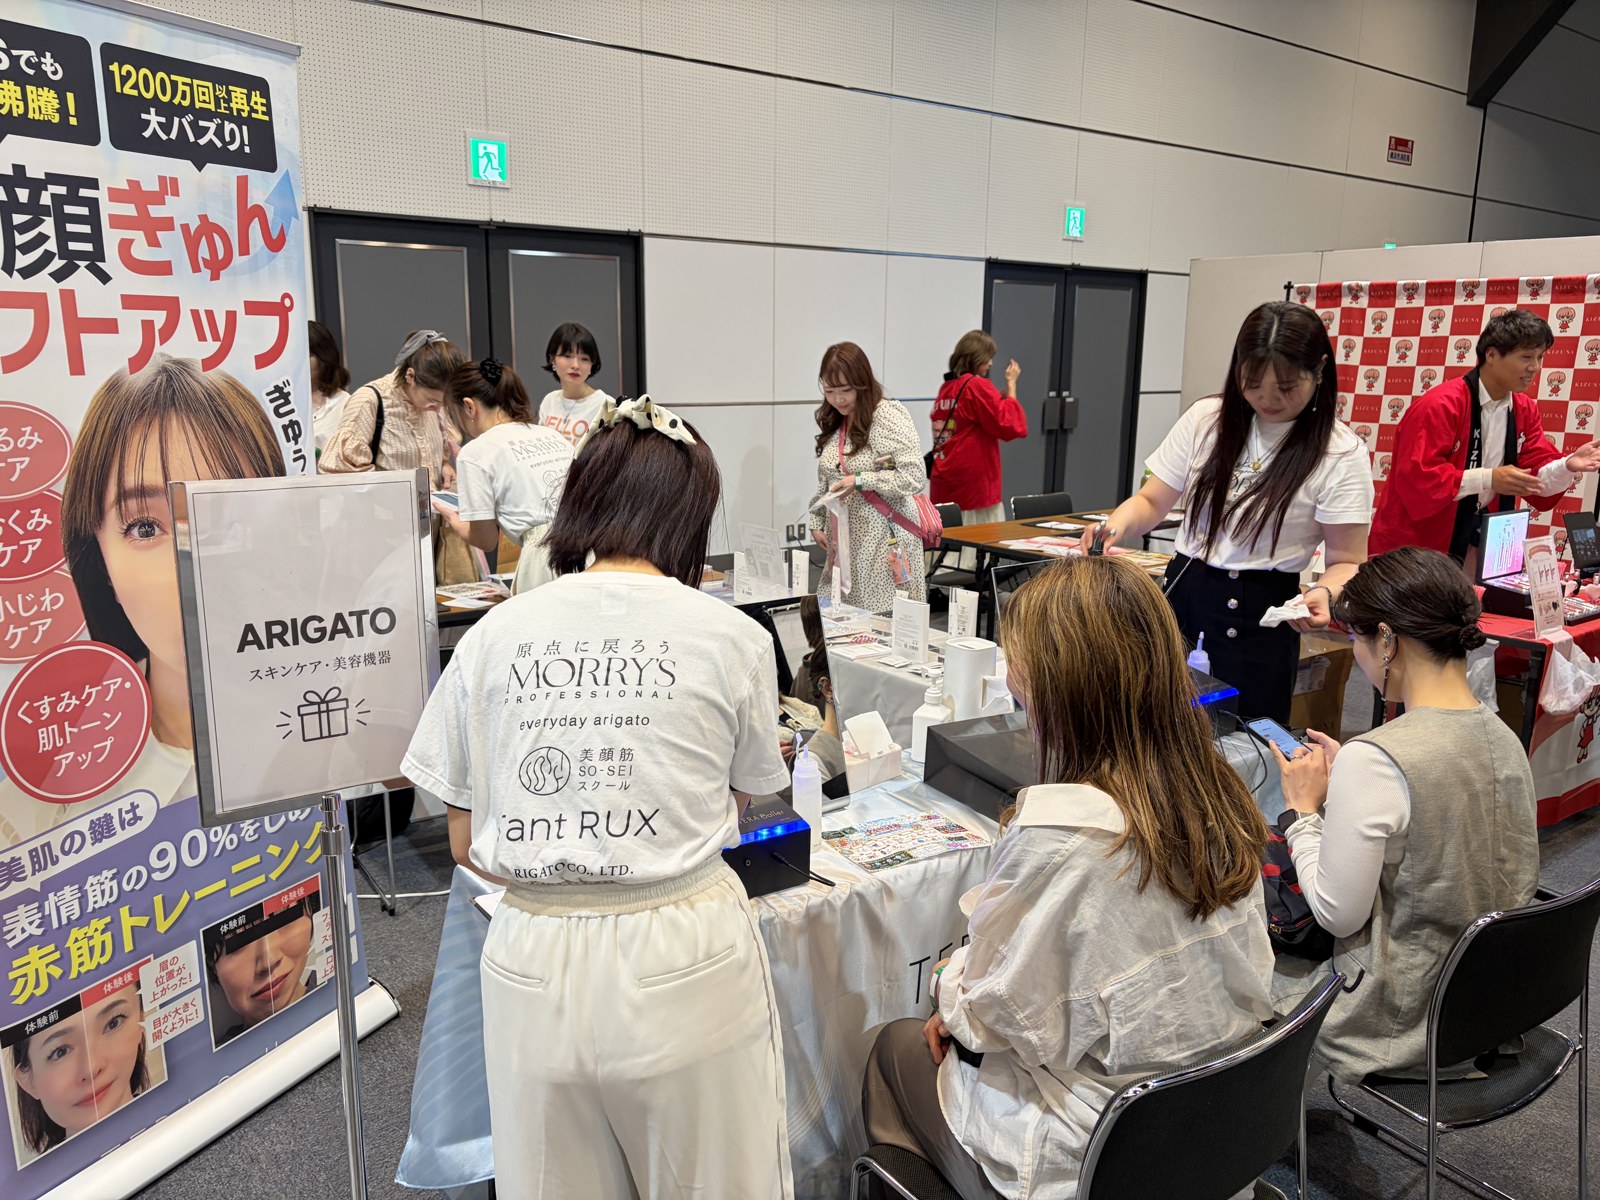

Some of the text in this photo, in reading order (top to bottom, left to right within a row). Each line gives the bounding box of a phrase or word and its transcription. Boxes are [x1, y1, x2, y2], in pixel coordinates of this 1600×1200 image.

[140, 107, 251, 154] 大バズり!
[0, 457, 30, 481] ア
[0, 508, 52, 535] くみ
[4, 618, 52, 649] ケア
[236, 606, 397, 653] ARIGATO
[248, 650, 392, 682] スキンケア・美容機器
[506, 657, 676, 694] MORRY'S
[504, 690, 674, 706] PROFESSIONAL
[38, 711, 122, 753] 肌トーン
[520, 714, 650, 730] everyday arigato
[54, 736, 114, 777] アップ
[580, 747, 634, 762] 美顔筋
[578, 765, 633, 777] SO-SEI
[577, 780, 631, 792] スクール
[501, 808, 660, 841] ant RUX
[0, 801, 143, 892] 美肌の鍵は
[600, 865, 634, 876] LTD.
[280, 886, 305, 905] 体験後
[219, 914, 247, 935] 体験前
[154, 963, 186, 988] 位置が
[158, 955, 179, 974] 眉の
[102, 971, 134, 994] 体験後
[149, 972, 193, 1004] 上がった!
[24, 1009, 60, 1035] 体験前
[152, 998, 197, 1030] 目が大きく
[152, 1010, 199, 1043] 開くように!
